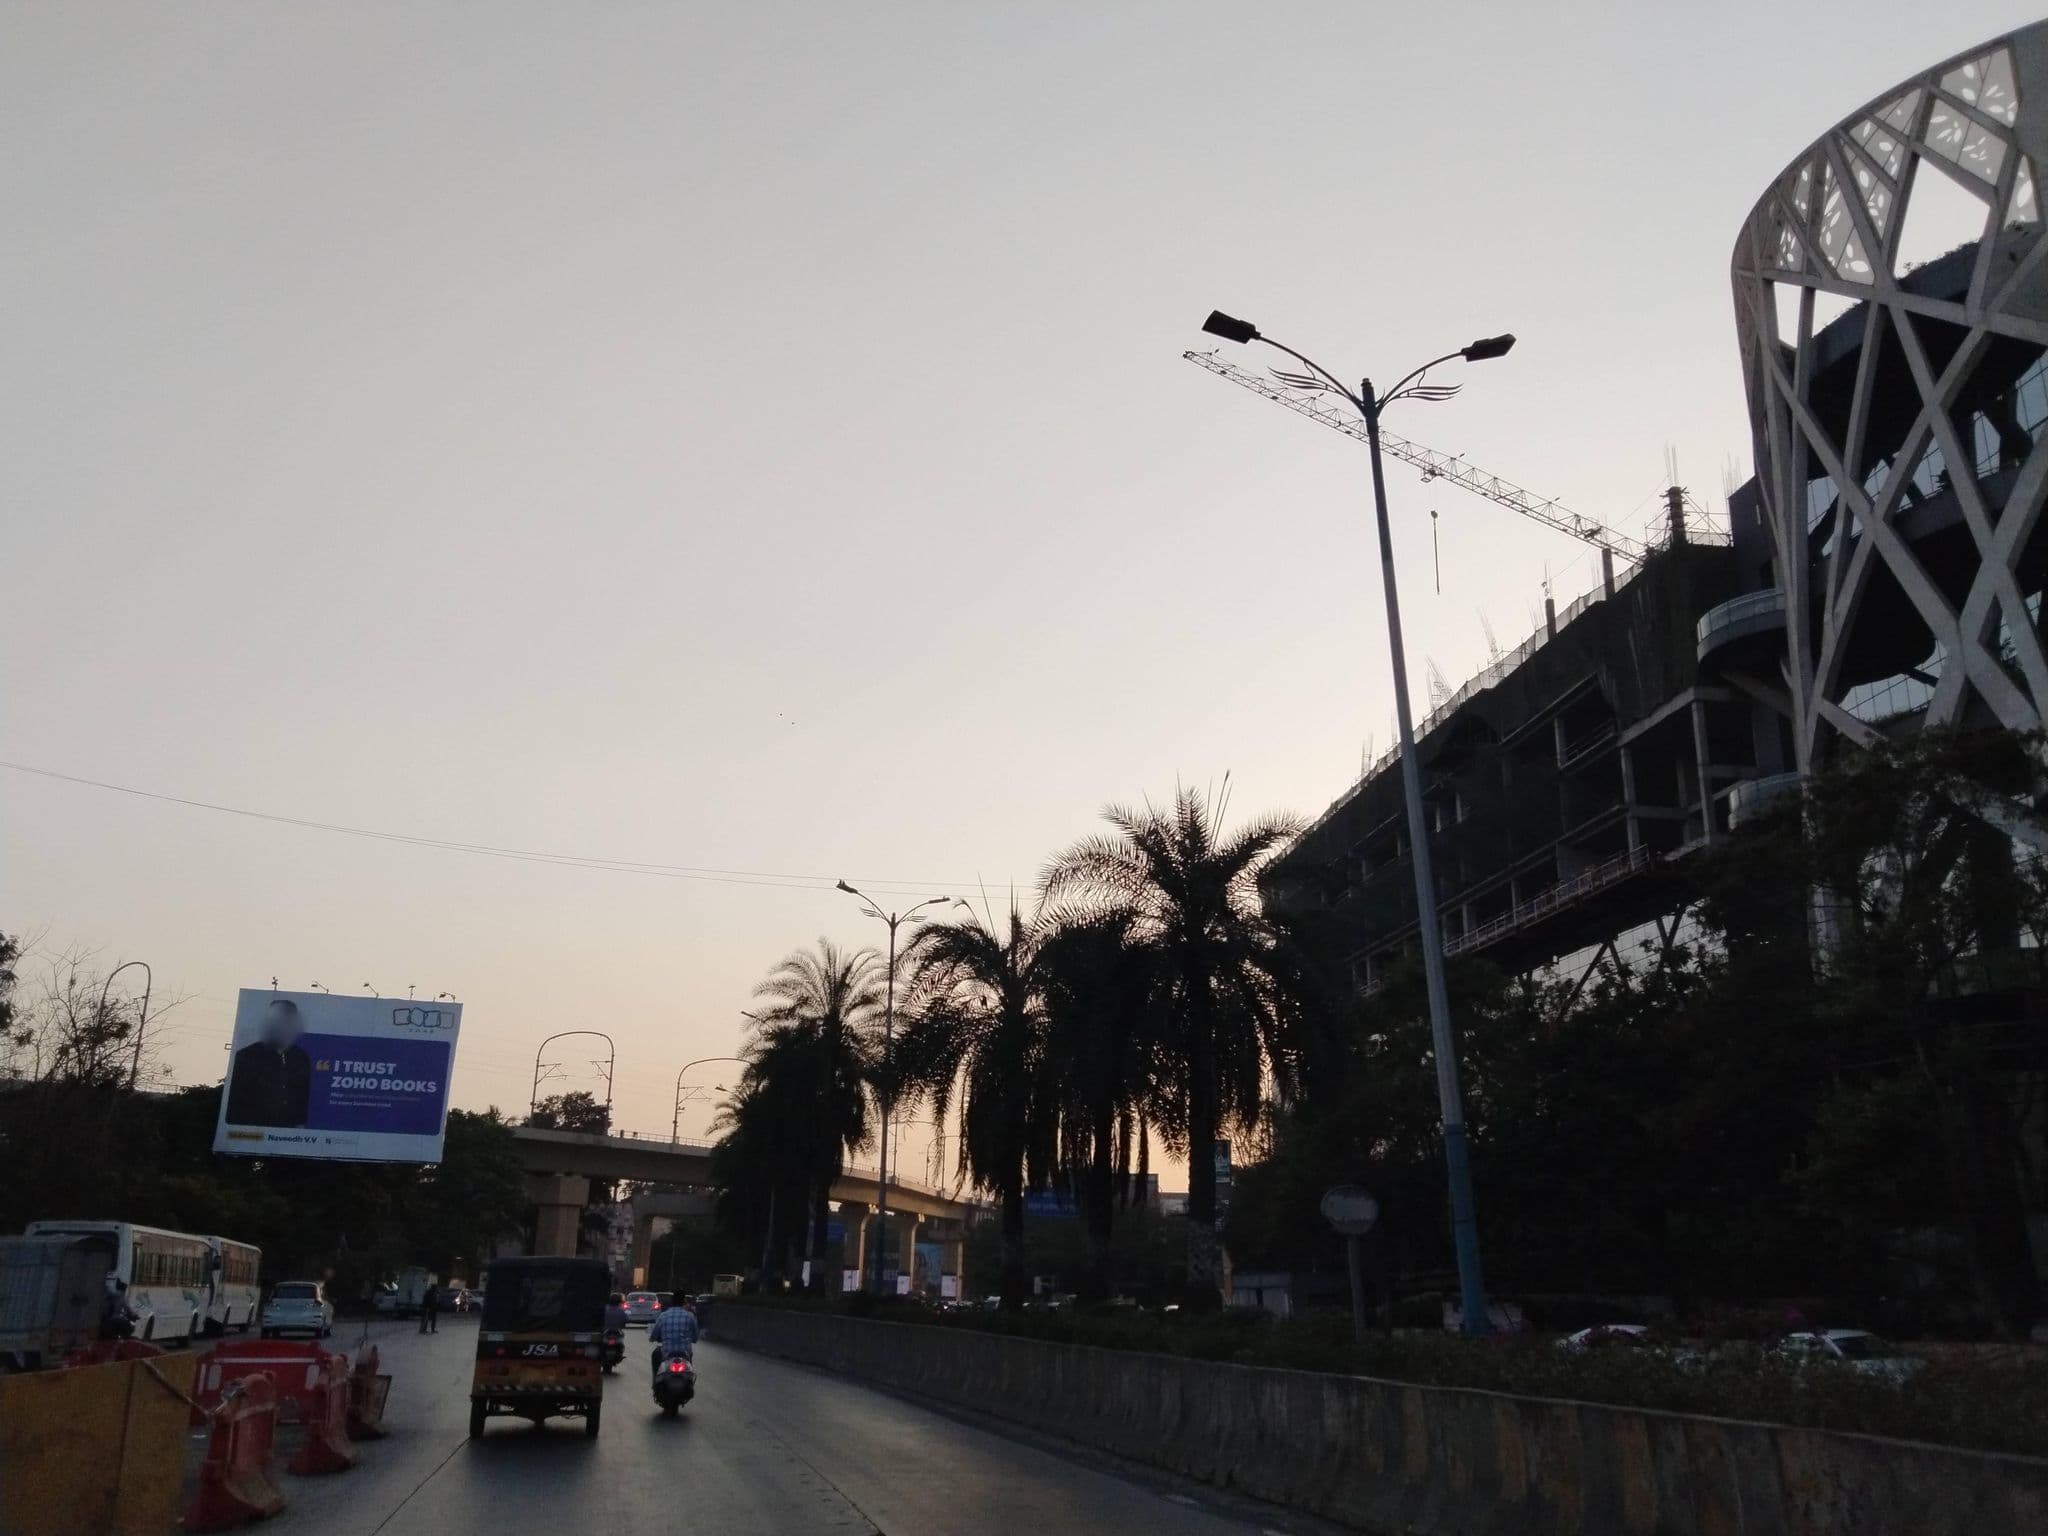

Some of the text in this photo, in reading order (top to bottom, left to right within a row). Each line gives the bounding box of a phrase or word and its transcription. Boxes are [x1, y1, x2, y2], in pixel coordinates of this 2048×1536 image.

[343, 1060, 397, 1075] TRUST
[331, 1076, 437, 1093] ZOHO BOOKS
[521, 1343, 560, 1356] JSA
